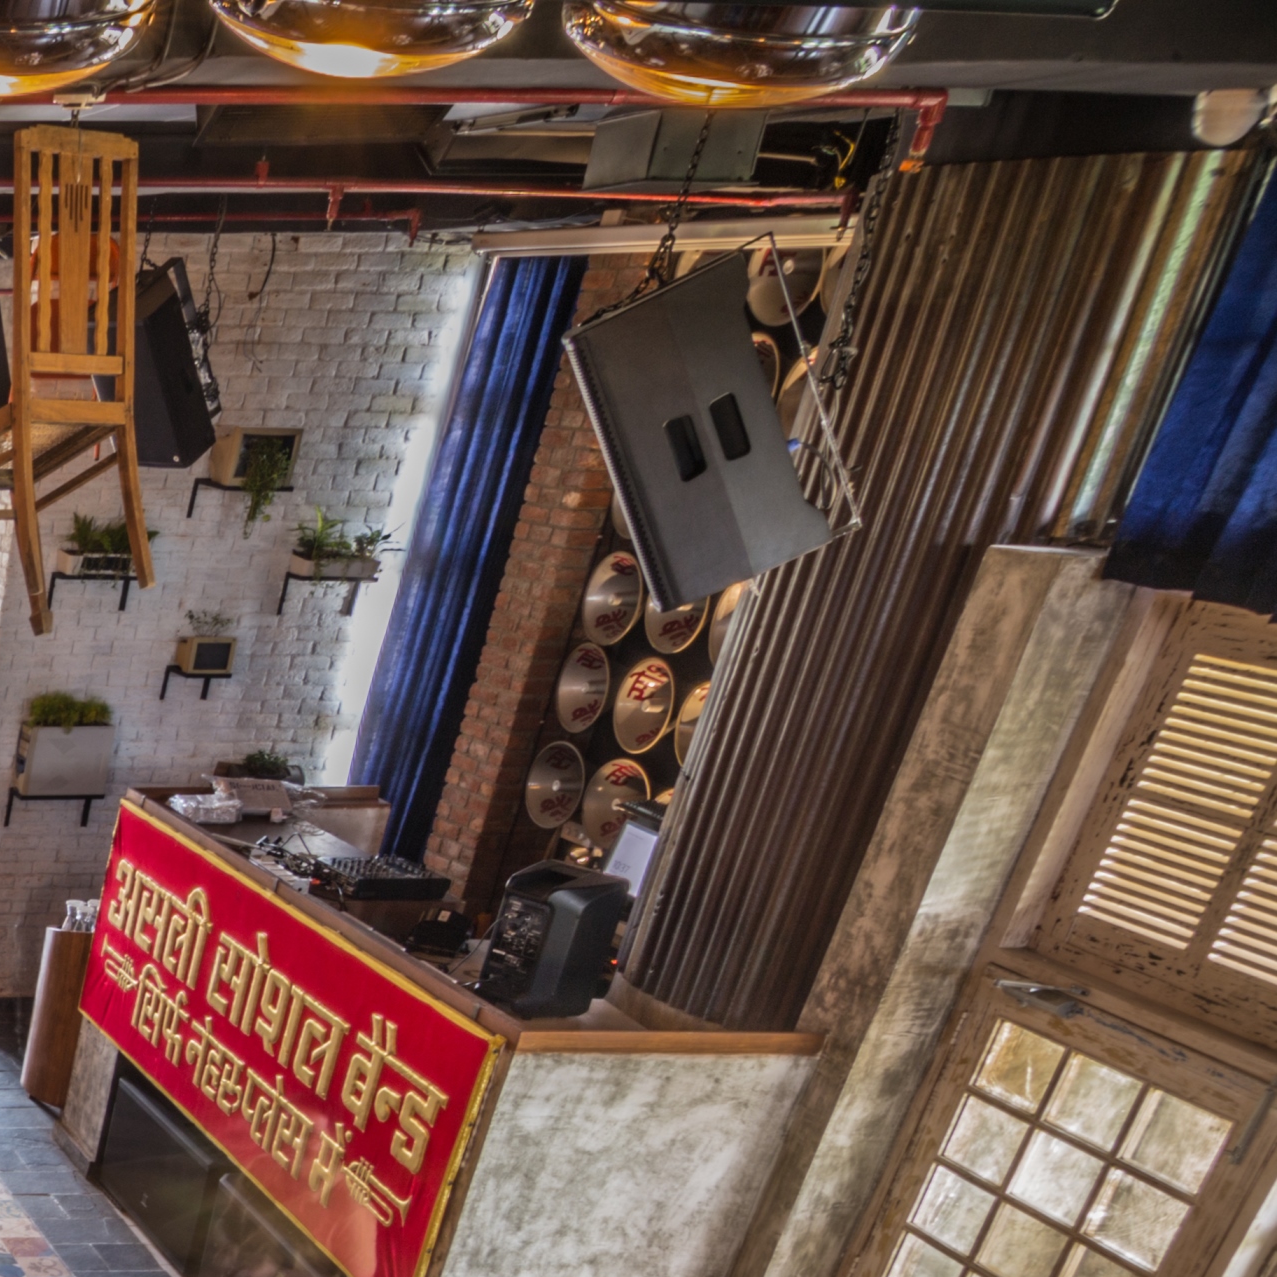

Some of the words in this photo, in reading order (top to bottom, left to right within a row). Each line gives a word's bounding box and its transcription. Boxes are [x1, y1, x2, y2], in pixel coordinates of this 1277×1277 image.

[107, 858, 214, 990] असली
[205, 932, 350, 1101] सोशल
[130, 963, 191, 1068] सिर्फ
[241, 1069, 316, 1179] प्लेस
[309, 1123, 353, 1209] में
